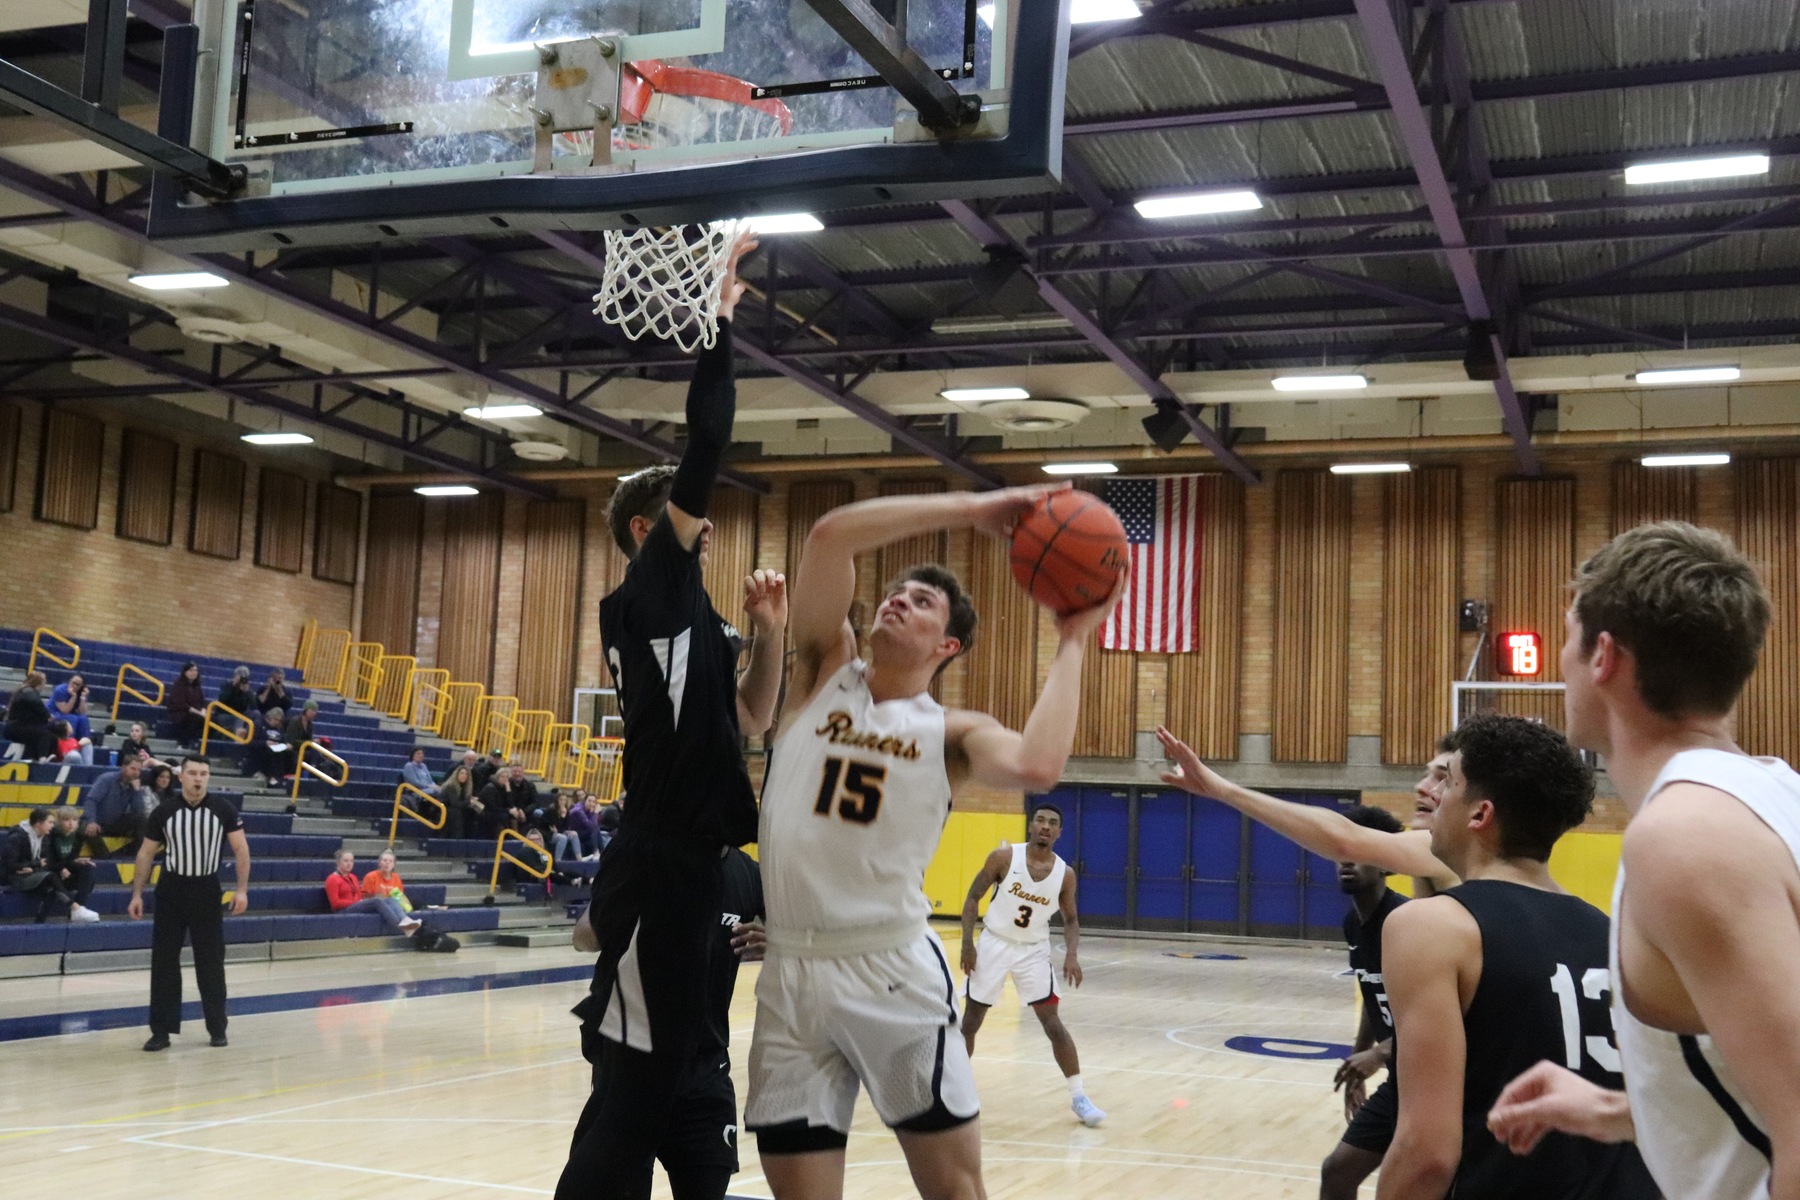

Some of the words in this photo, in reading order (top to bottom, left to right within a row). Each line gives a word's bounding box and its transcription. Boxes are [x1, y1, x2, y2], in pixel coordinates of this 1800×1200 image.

[1512, 646, 1537, 673] 18
[813, 755, 888, 826] 15
[1008, 882, 1051, 906] Runners
[1014, 905, 1033, 929] 3
[1549, 962, 1622, 1073] 13
